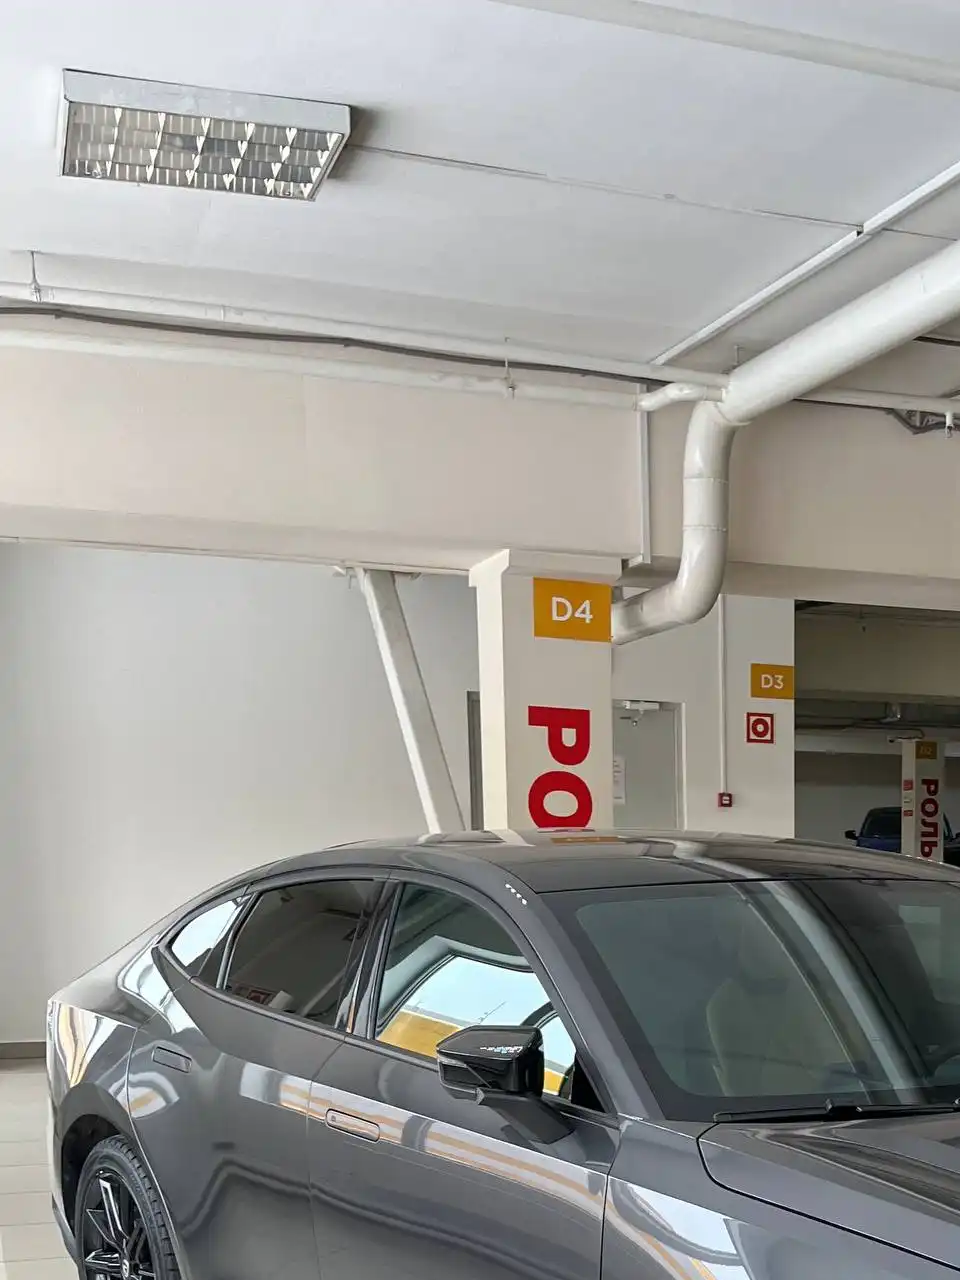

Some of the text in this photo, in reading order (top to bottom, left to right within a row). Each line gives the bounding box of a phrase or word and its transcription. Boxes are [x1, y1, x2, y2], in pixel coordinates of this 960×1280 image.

[551, 596, 593, 624] D4
[761, 674, 785, 690] D3
[527, 705, 593, 828] РО
[920, 778, 939, 858] РОЛЬ
